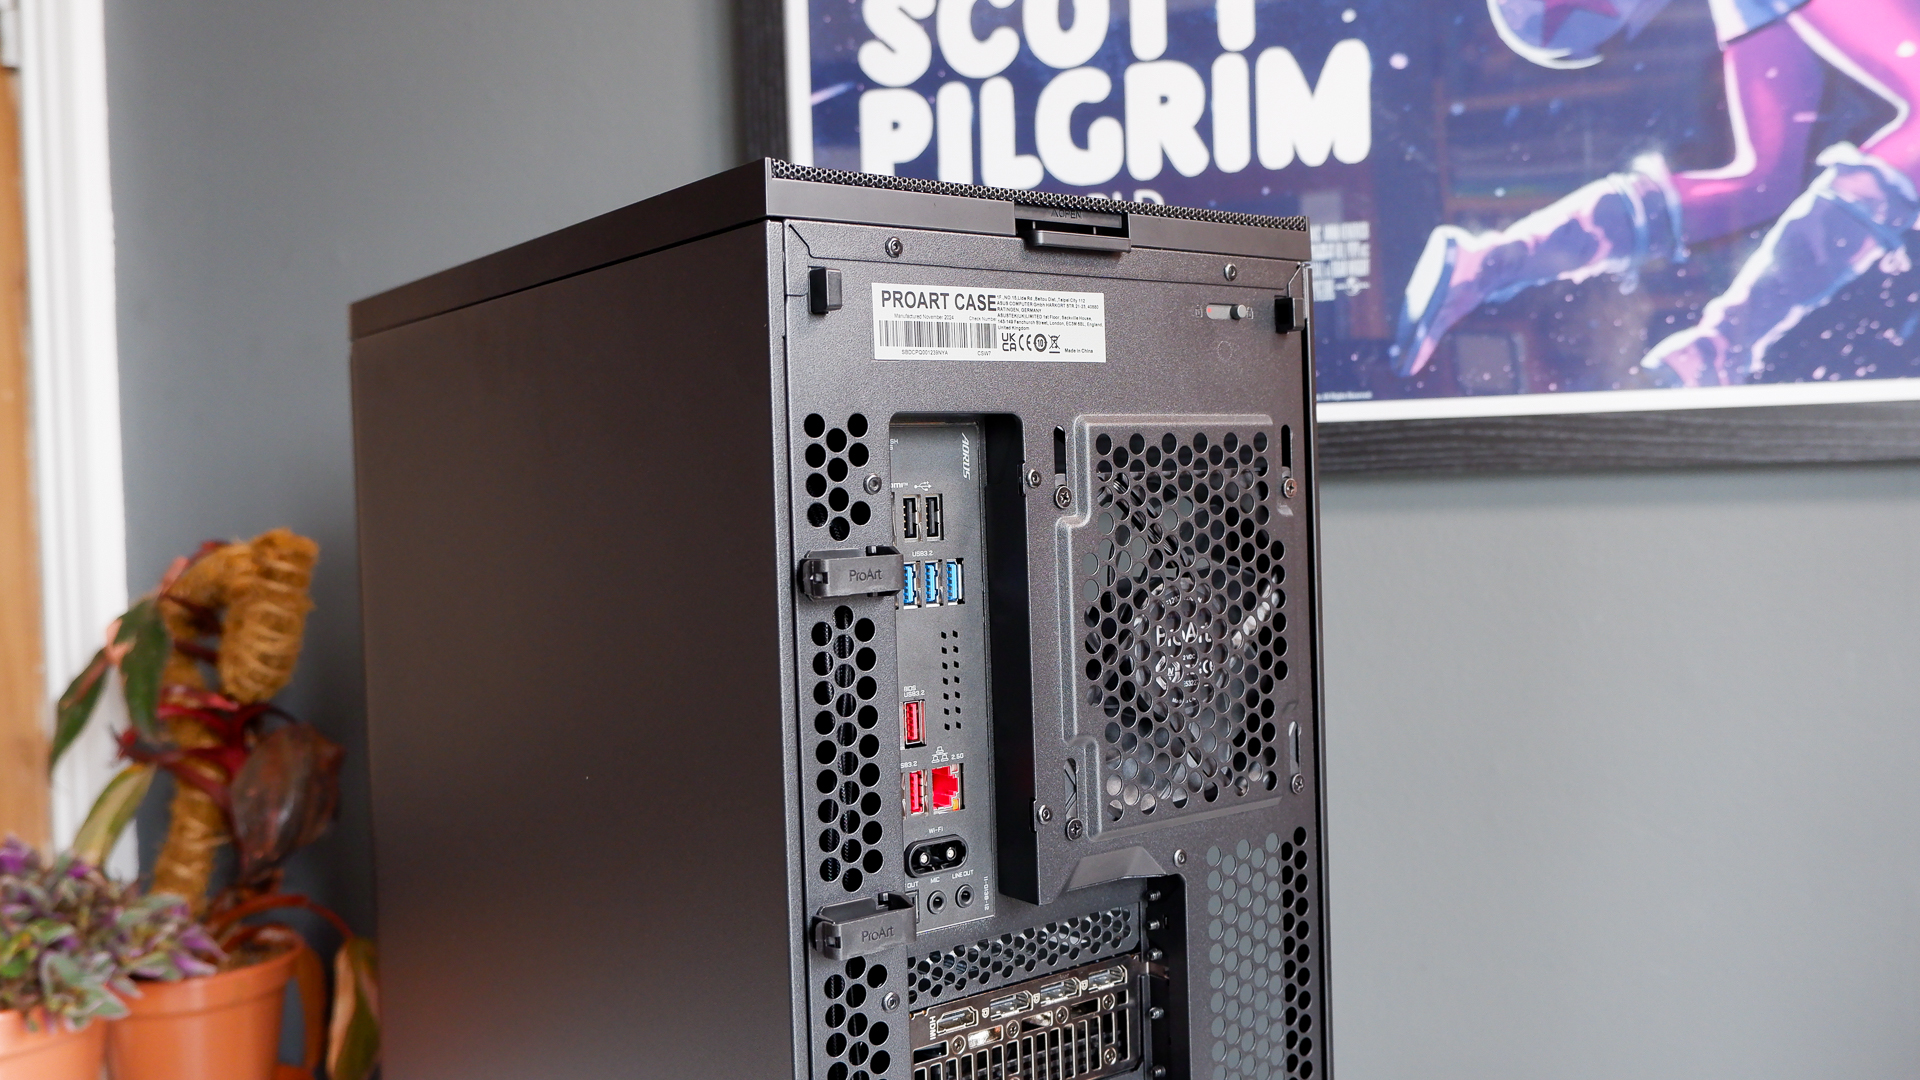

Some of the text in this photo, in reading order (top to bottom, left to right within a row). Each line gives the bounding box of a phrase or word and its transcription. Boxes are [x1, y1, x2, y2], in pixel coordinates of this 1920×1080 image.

[858, 38, 1372, 190] PILGRIM
[881, 290, 997, 312] PROART CASE
[961, 432, 971, 480] AORUS
[849, 568, 882, 582] ProArt
[862, 926, 894, 942] ProArt
[929, 1016, 937, 1041] HDMI
